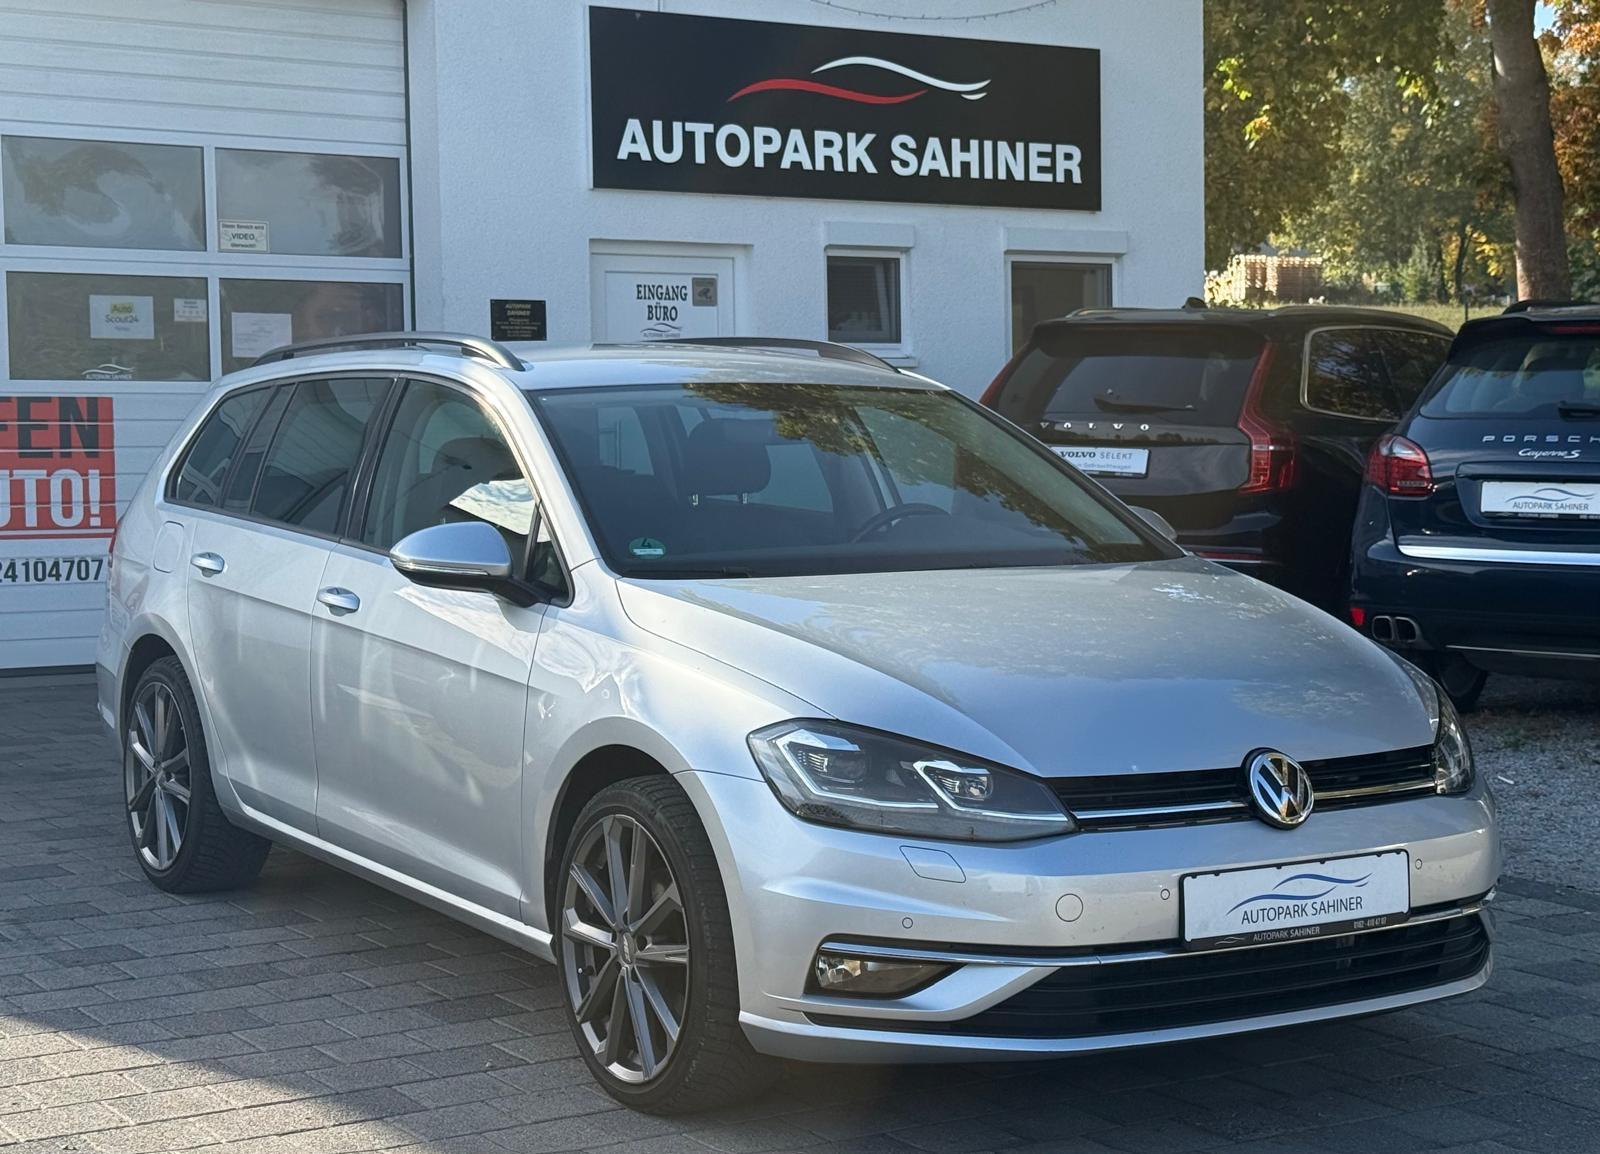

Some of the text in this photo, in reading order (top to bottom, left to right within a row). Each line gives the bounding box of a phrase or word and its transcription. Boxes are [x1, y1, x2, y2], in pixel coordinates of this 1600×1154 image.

[616, 118, 1083, 184] AUTOPARK SAHINER
[231, 233, 255, 241] VIDEO
[636, 284, 688, 302] EINGANG
[112, 304, 133, 314] Auto
[647, 302, 678, 322] BÜRO
[105, 314, 139, 324] Scout24
[1040, 422, 1150, 431] VOLVO
[1060, 451, 1133, 460] VOLVO SELEKT
[1518, 448, 1581, 459] Cayenne S
[1512, 501, 1589, 511] AUTOPARK SAHINER
[0, 558, 104, 582] 4104707
[1241, 895, 1363, 925] AUTOPARK SAHINER
[1253, 931, 1288, 942] AUTOPARK
[1290, 927, 1320, 938] SAHINER
